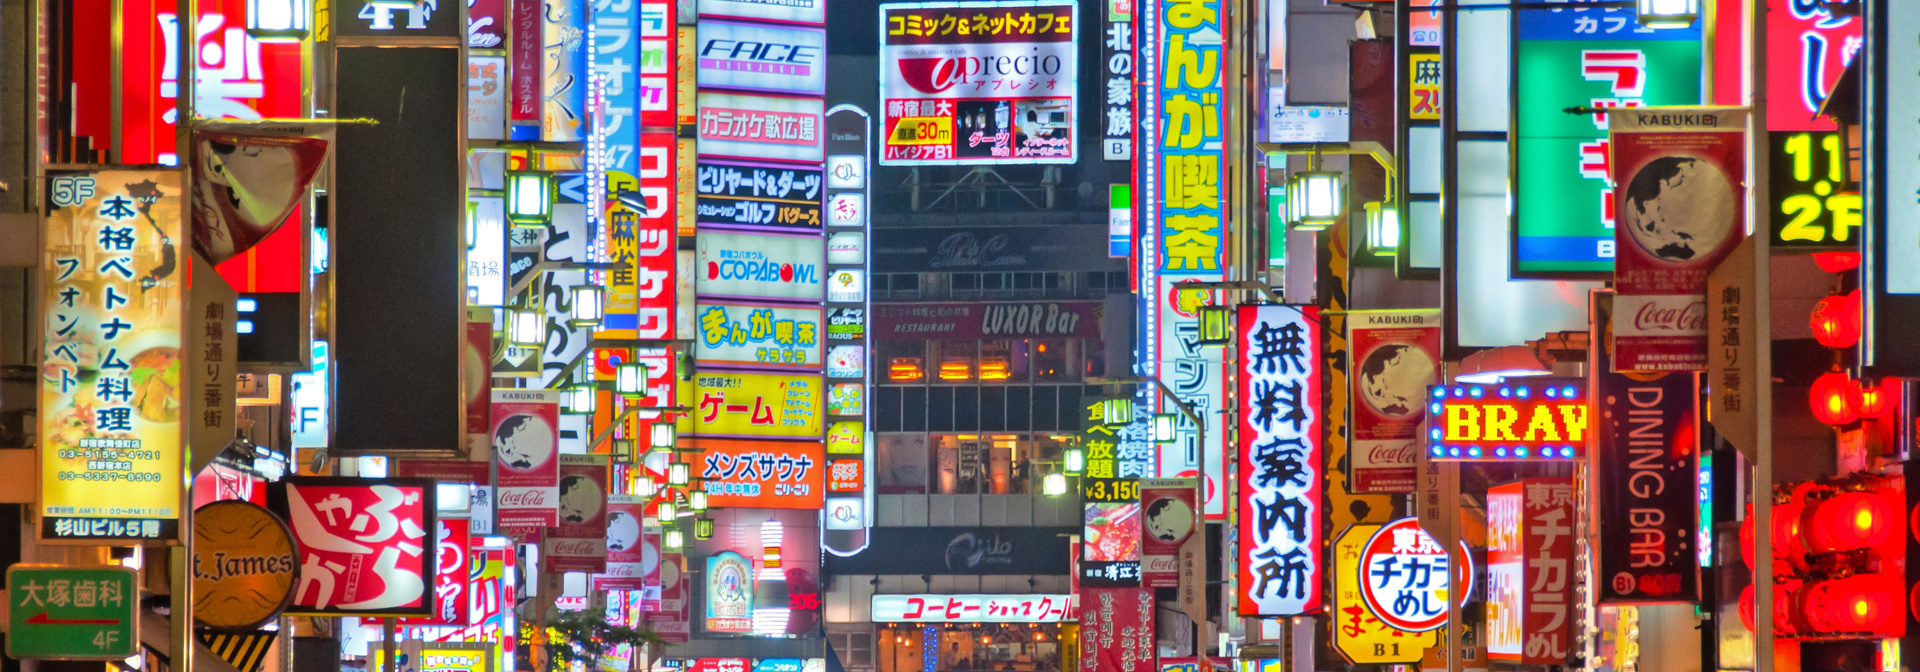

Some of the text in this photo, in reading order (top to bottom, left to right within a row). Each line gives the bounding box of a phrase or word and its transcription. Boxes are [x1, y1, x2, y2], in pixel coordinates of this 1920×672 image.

[888, 12, 1071, 37] コミック&ネットカフェ
[520, 2, 533, 114] レンタルルーム ホステル
[701, 38, 821, 65] FACE
[715, 60, 796, 76] SHINJUKU
[1106, 22, 1131, 137] 北の家族
[974, 80, 1057, 92] アプレシオ
[888, 100, 954, 119] 新宿最大
[702, 110, 816, 142] カラオケ歌広場
[968, 131, 1010, 148] ダーツ
[887, 145, 954, 159] ハイジアB1
[51, 177, 96, 206] 5F
[697, 166, 821, 201] ビリヤード&ダーツ
[1112, 216, 1131, 228] Fam
[56, 258, 81, 394] フォンベト
[99, 195, 136, 432] 本格ベトナム料理
[698, 304, 818, 350] まんが喫茶
[894, 323, 956, 333] RESTAURANT
[982, 303, 1080, 335] LUXOR Bar
[1721, 285, 1742, 414] 劇場通り一番街
[204, 301, 224, 429] 劇場通り一番街
[699, 391, 776, 426] ゲーム
[57, 449, 161, 461] 03-5155-4721
[1627, 387, 1665, 499] DINING
[702, 452, 813, 483] メンズサウナ
[1249, 320, 1309, 604] 無料案内所
[57, 472, 162, 482] 03-5337-8590
[1524, 482, 1573, 511] 東京
[55, 518, 161, 538] 杉山ビル5階
[1629, 508, 1666, 568] BAR
[1530, 507, 1572, 634] チカラ
[20, 578, 123, 608] 大塚歯科
[1393, 589, 1443, 618] めし
[901, 596, 980, 620] コーヒー
[92, 629, 120, 651] 4F
[1525, 632, 1568, 660] めし
